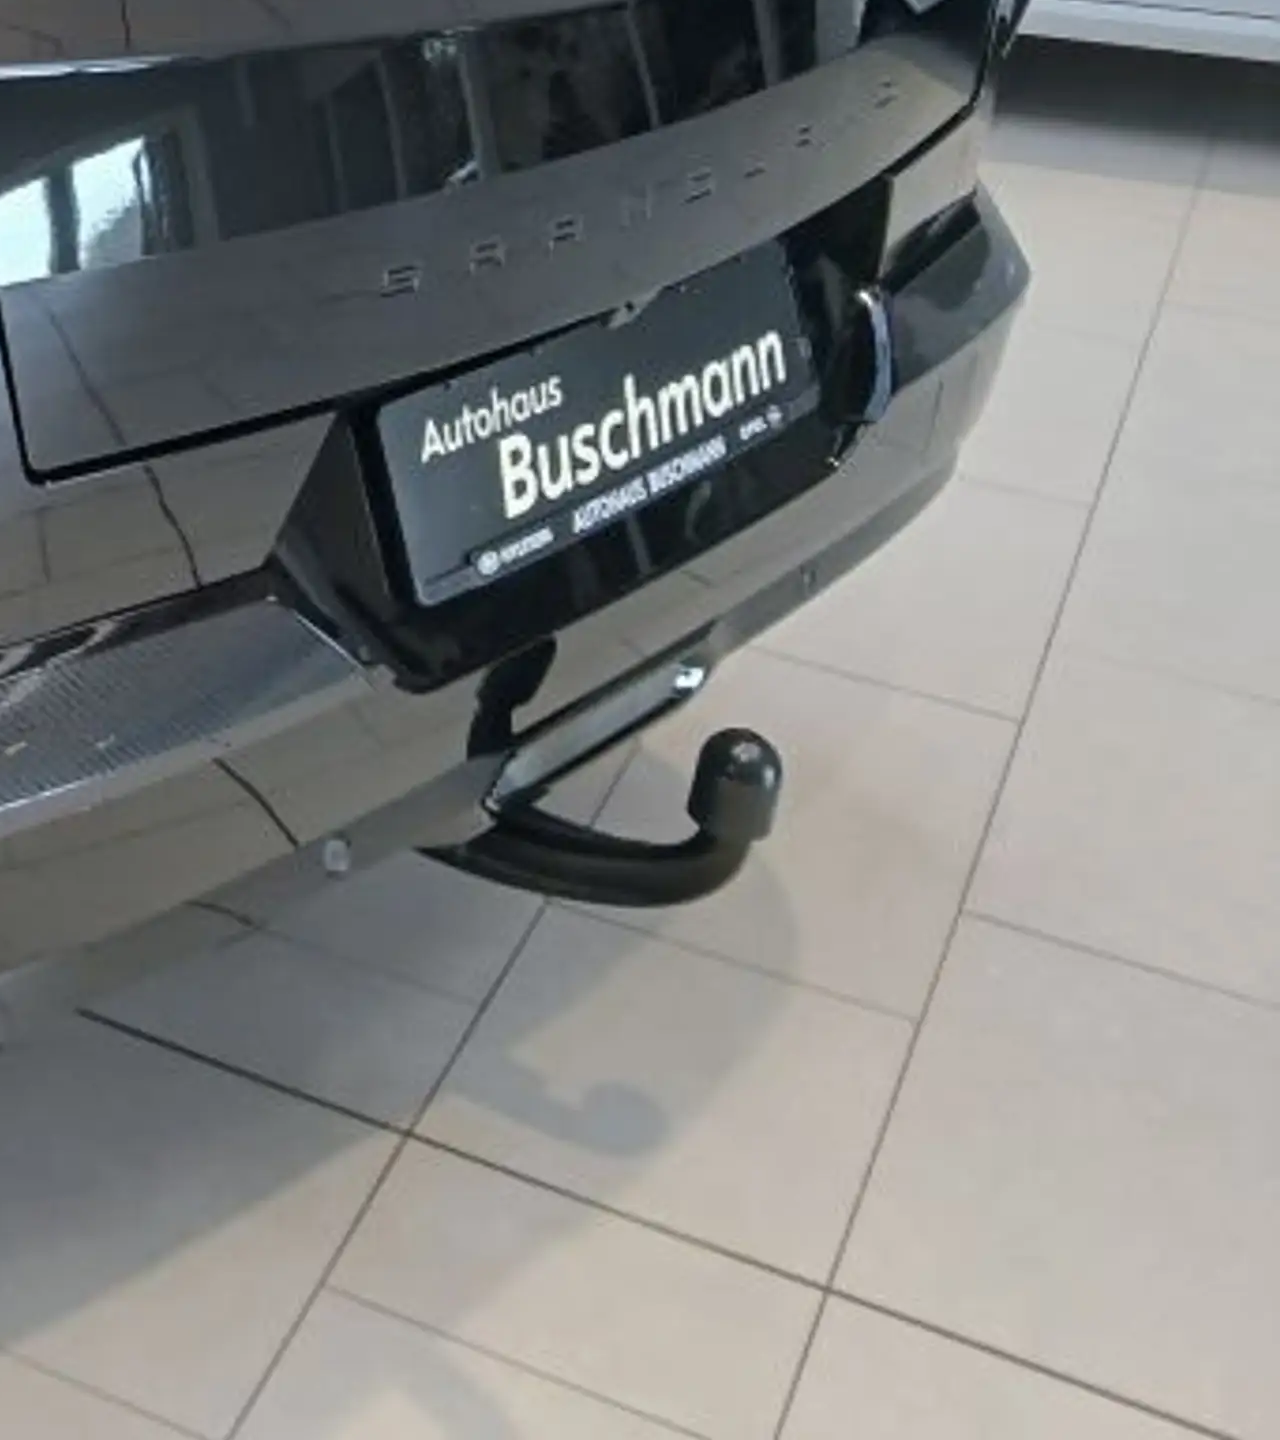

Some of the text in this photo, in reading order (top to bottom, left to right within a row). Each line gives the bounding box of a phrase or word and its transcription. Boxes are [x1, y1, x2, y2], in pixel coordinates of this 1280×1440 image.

[381, 70, 899, 298] GRANDLAD
[419, 375, 563, 464] Autohaus
[499, 329, 787, 520] Buschmann
[572, 435, 728, 534] AUTOHAUS BUSCHMANN
